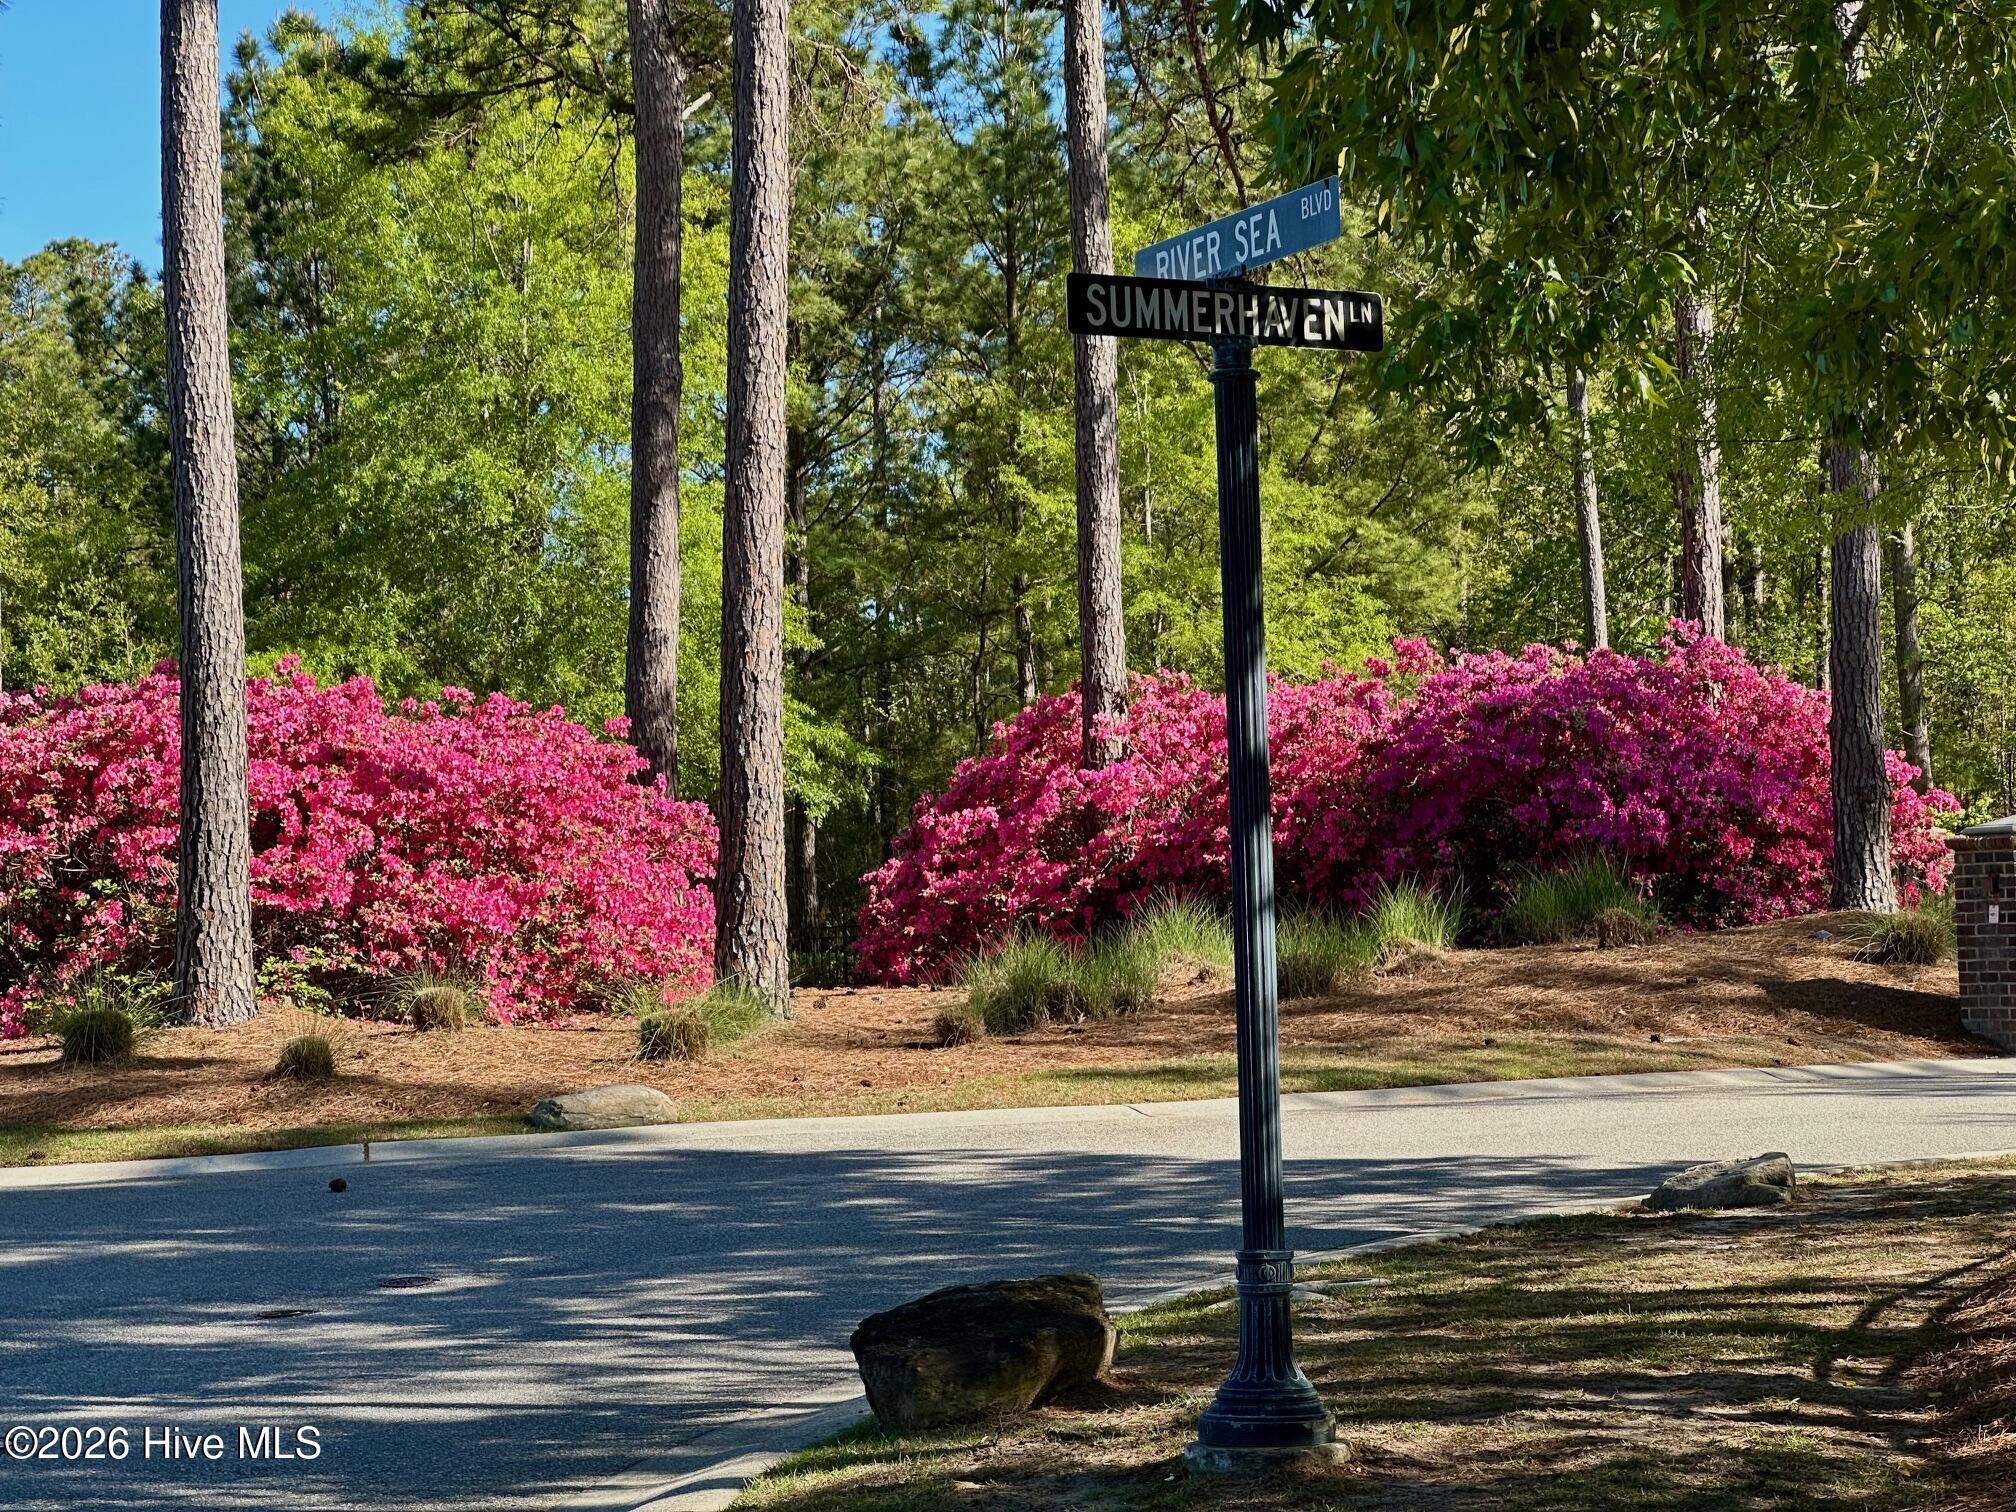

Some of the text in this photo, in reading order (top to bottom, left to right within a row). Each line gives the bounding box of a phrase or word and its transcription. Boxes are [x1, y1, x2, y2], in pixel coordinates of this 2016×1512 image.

[1156, 189, 1332, 281] RIVER SEA BLVD
[1086, 283, 1372, 342] SUMMERHAVEN LN
